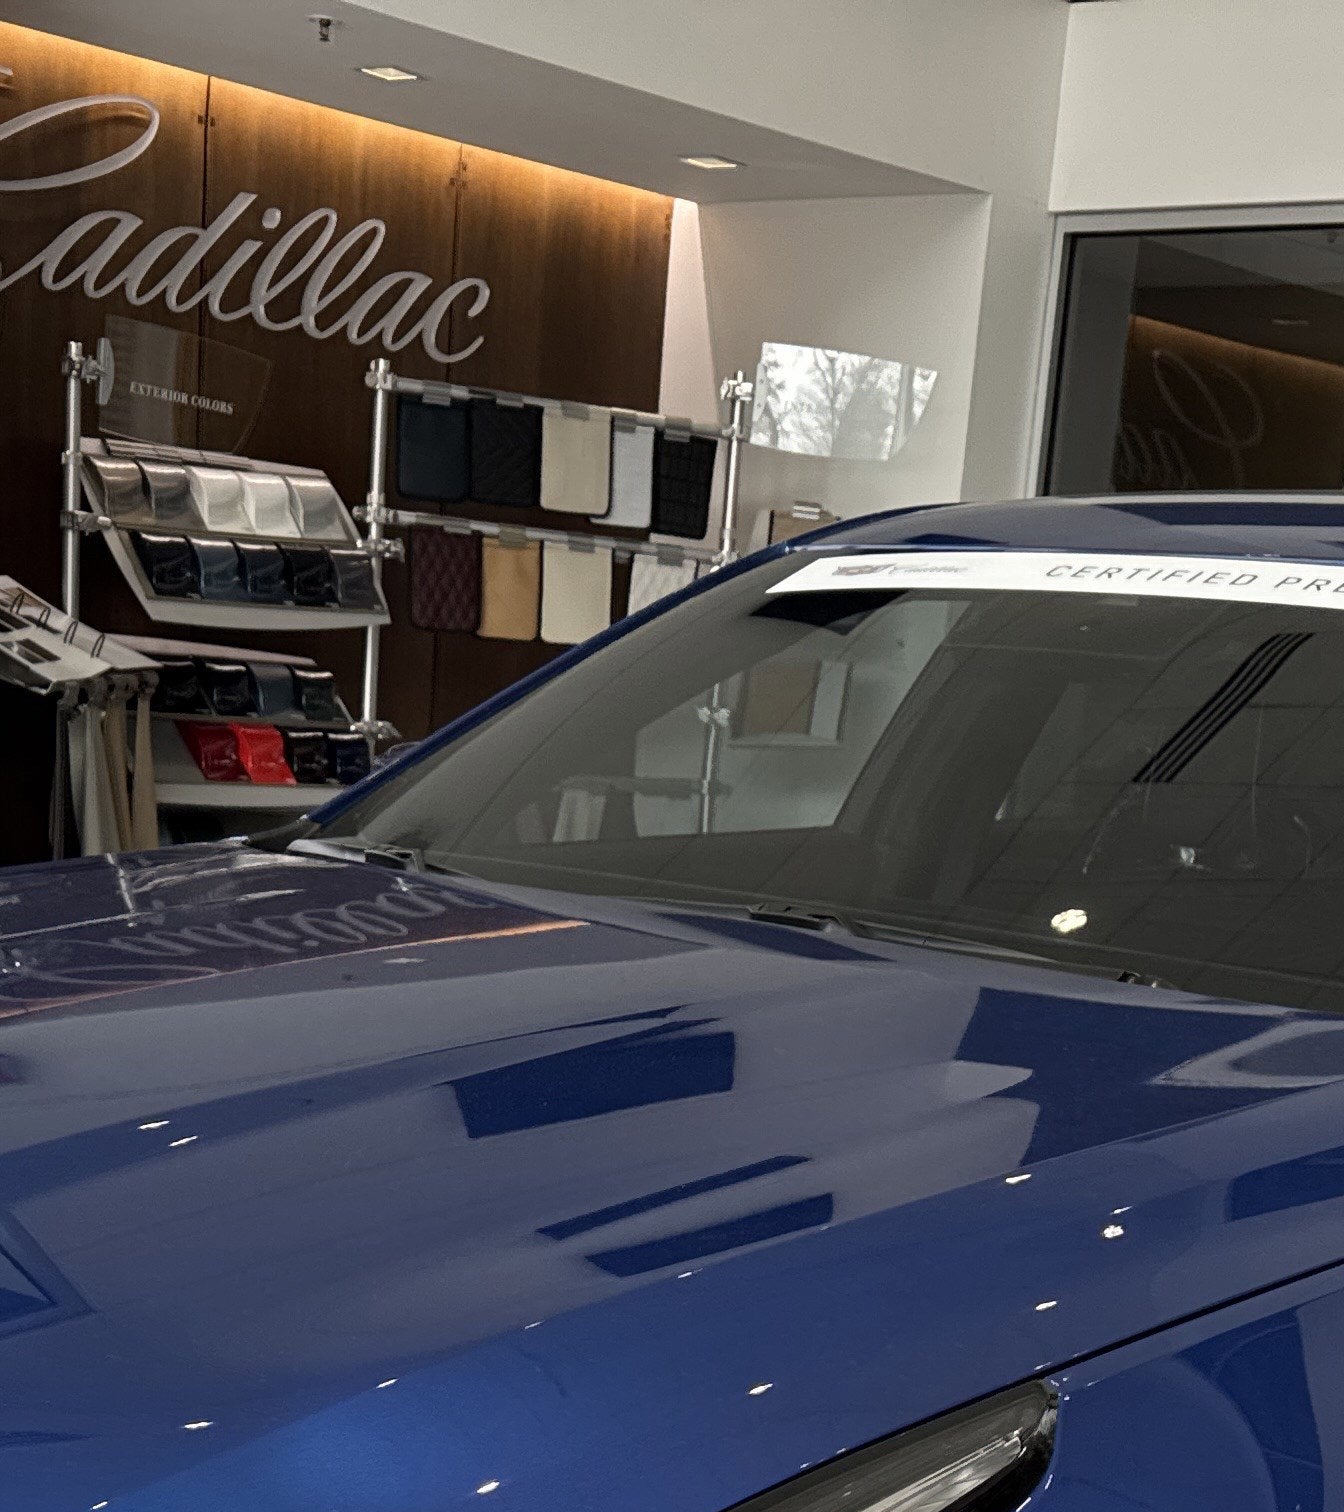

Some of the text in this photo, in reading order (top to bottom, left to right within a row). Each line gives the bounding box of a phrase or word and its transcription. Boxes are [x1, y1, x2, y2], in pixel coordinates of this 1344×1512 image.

[129, 381, 235, 415] EXTERIOR COLORS
[1045, 565, 1259, 587] CERTIFIED
